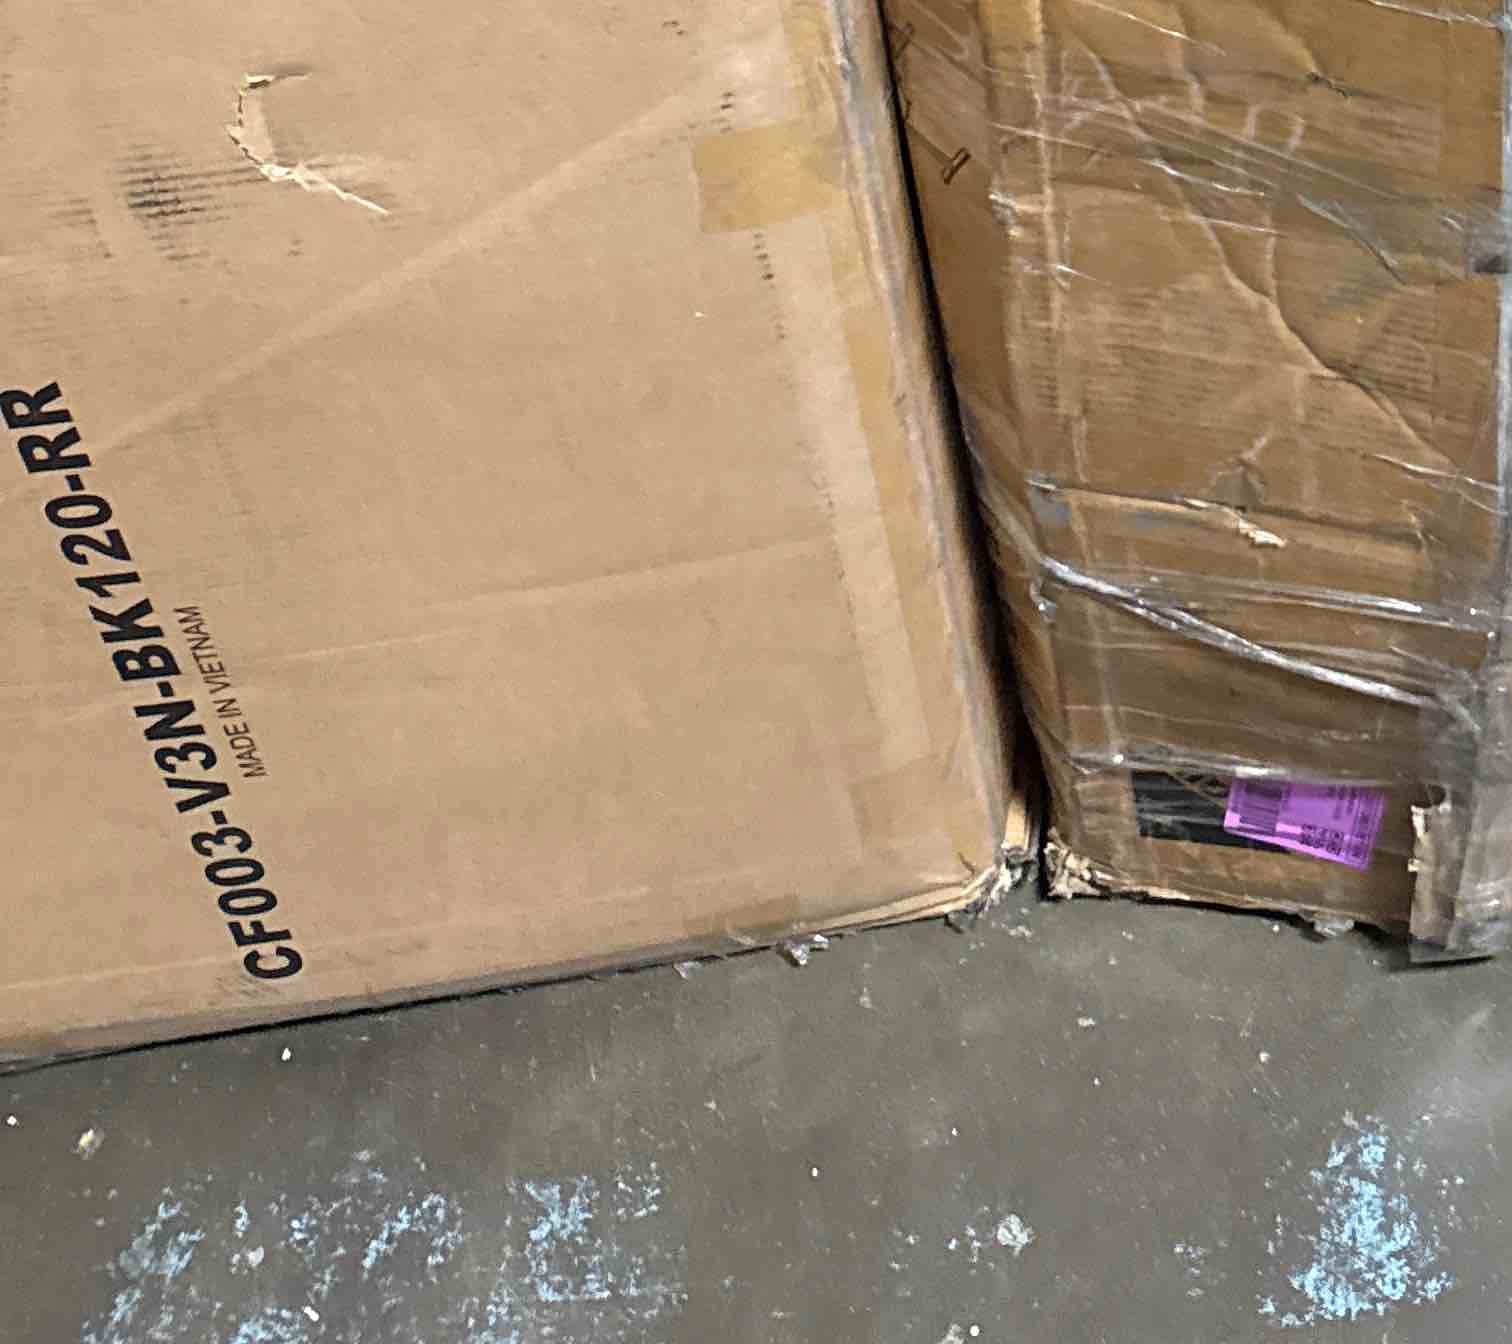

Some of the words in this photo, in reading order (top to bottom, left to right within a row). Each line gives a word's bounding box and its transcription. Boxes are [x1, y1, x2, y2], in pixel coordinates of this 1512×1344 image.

[0, 381, 302, 980] CF003-V3N-BK120-RR
[173, 605, 232, 695] VIETNAM
[212, 697, 243, 719] IN
[223, 722, 271, 778] MADE
